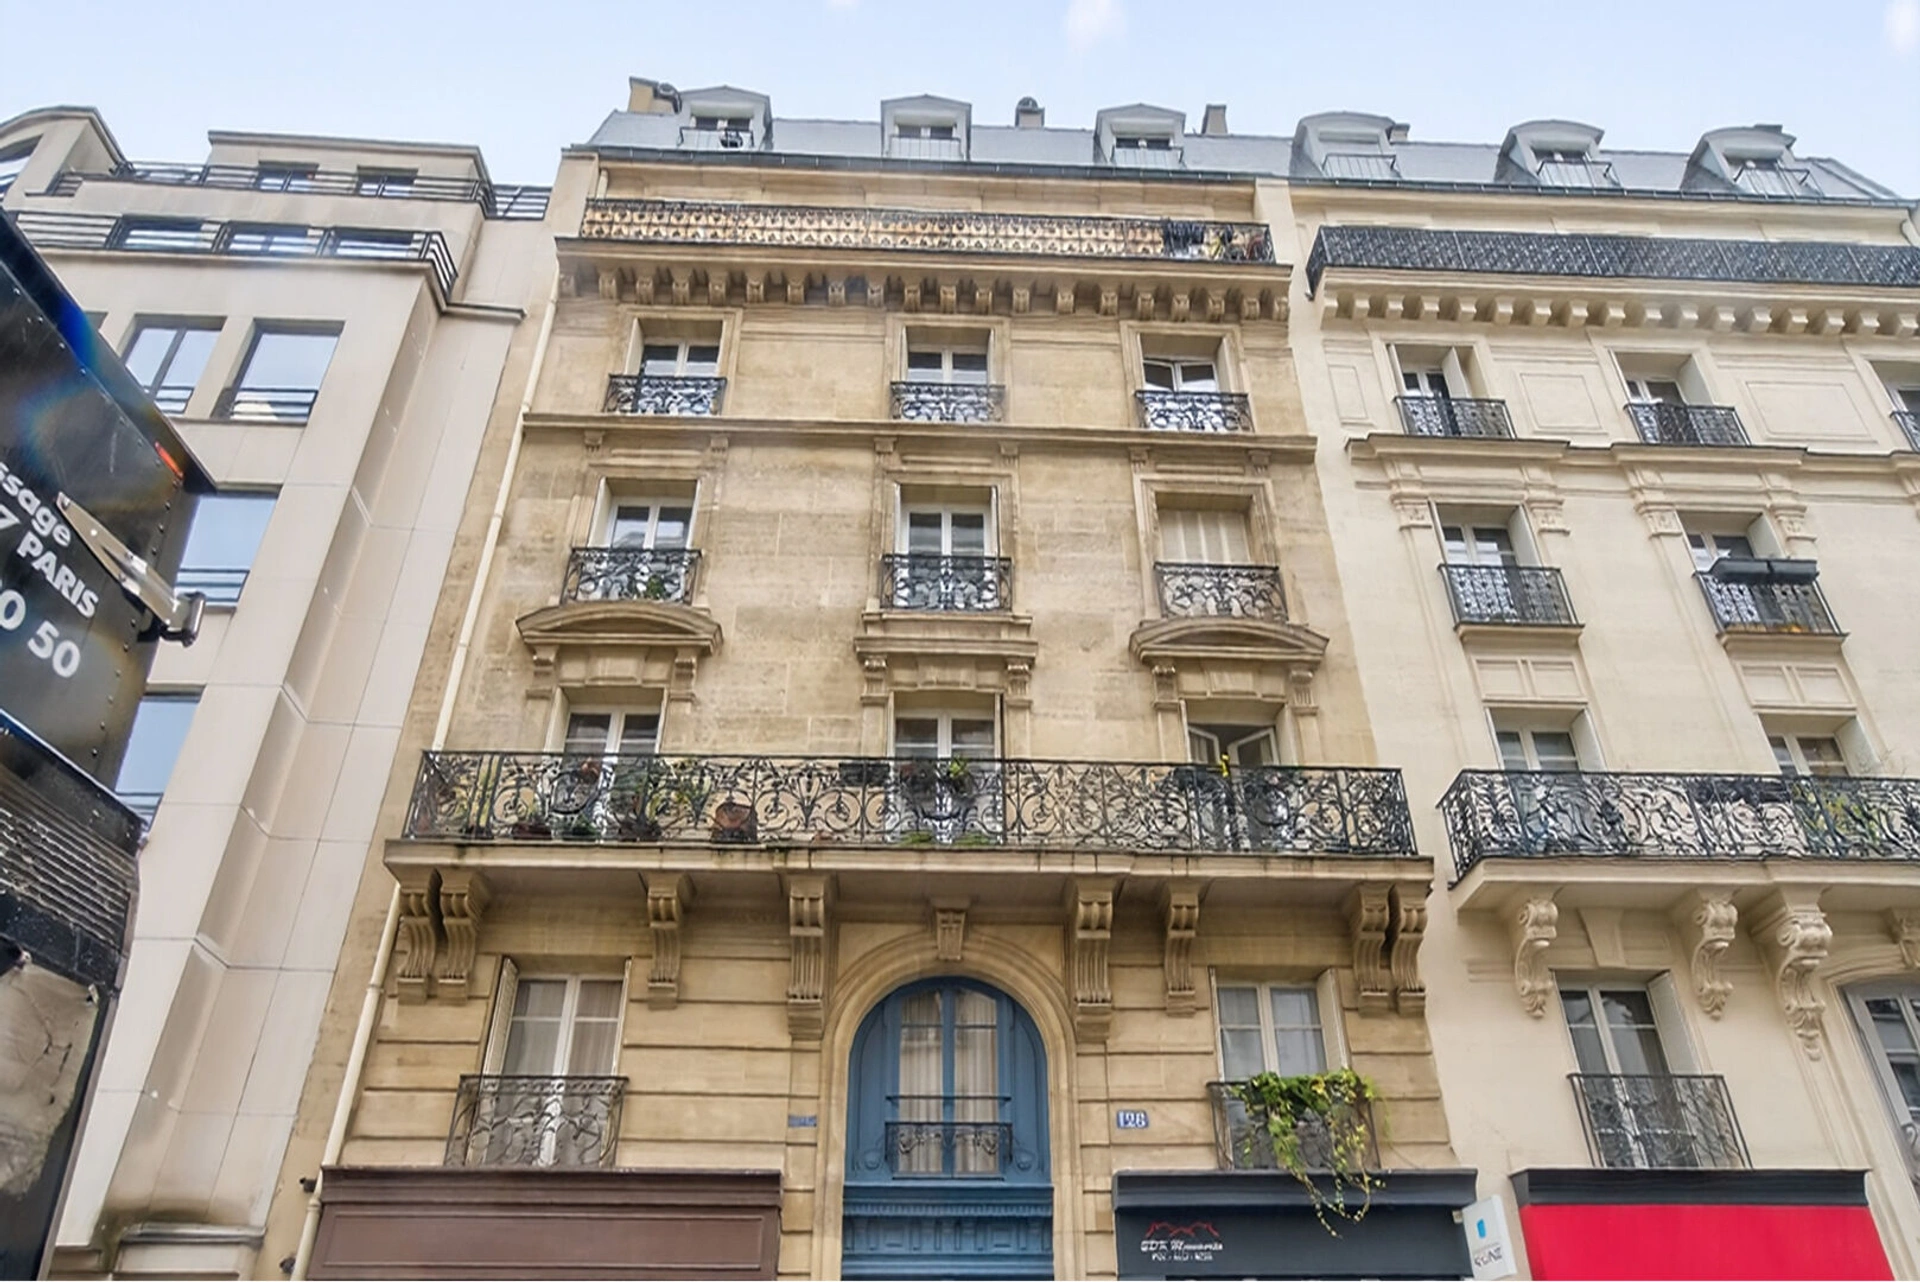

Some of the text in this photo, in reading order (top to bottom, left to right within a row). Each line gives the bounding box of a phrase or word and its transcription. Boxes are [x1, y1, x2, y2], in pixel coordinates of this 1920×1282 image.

[17, 530, 99, 619] PARIS
[27, 620, 81, 678] 50
[1118, 1111, 1146, 1129] 128
